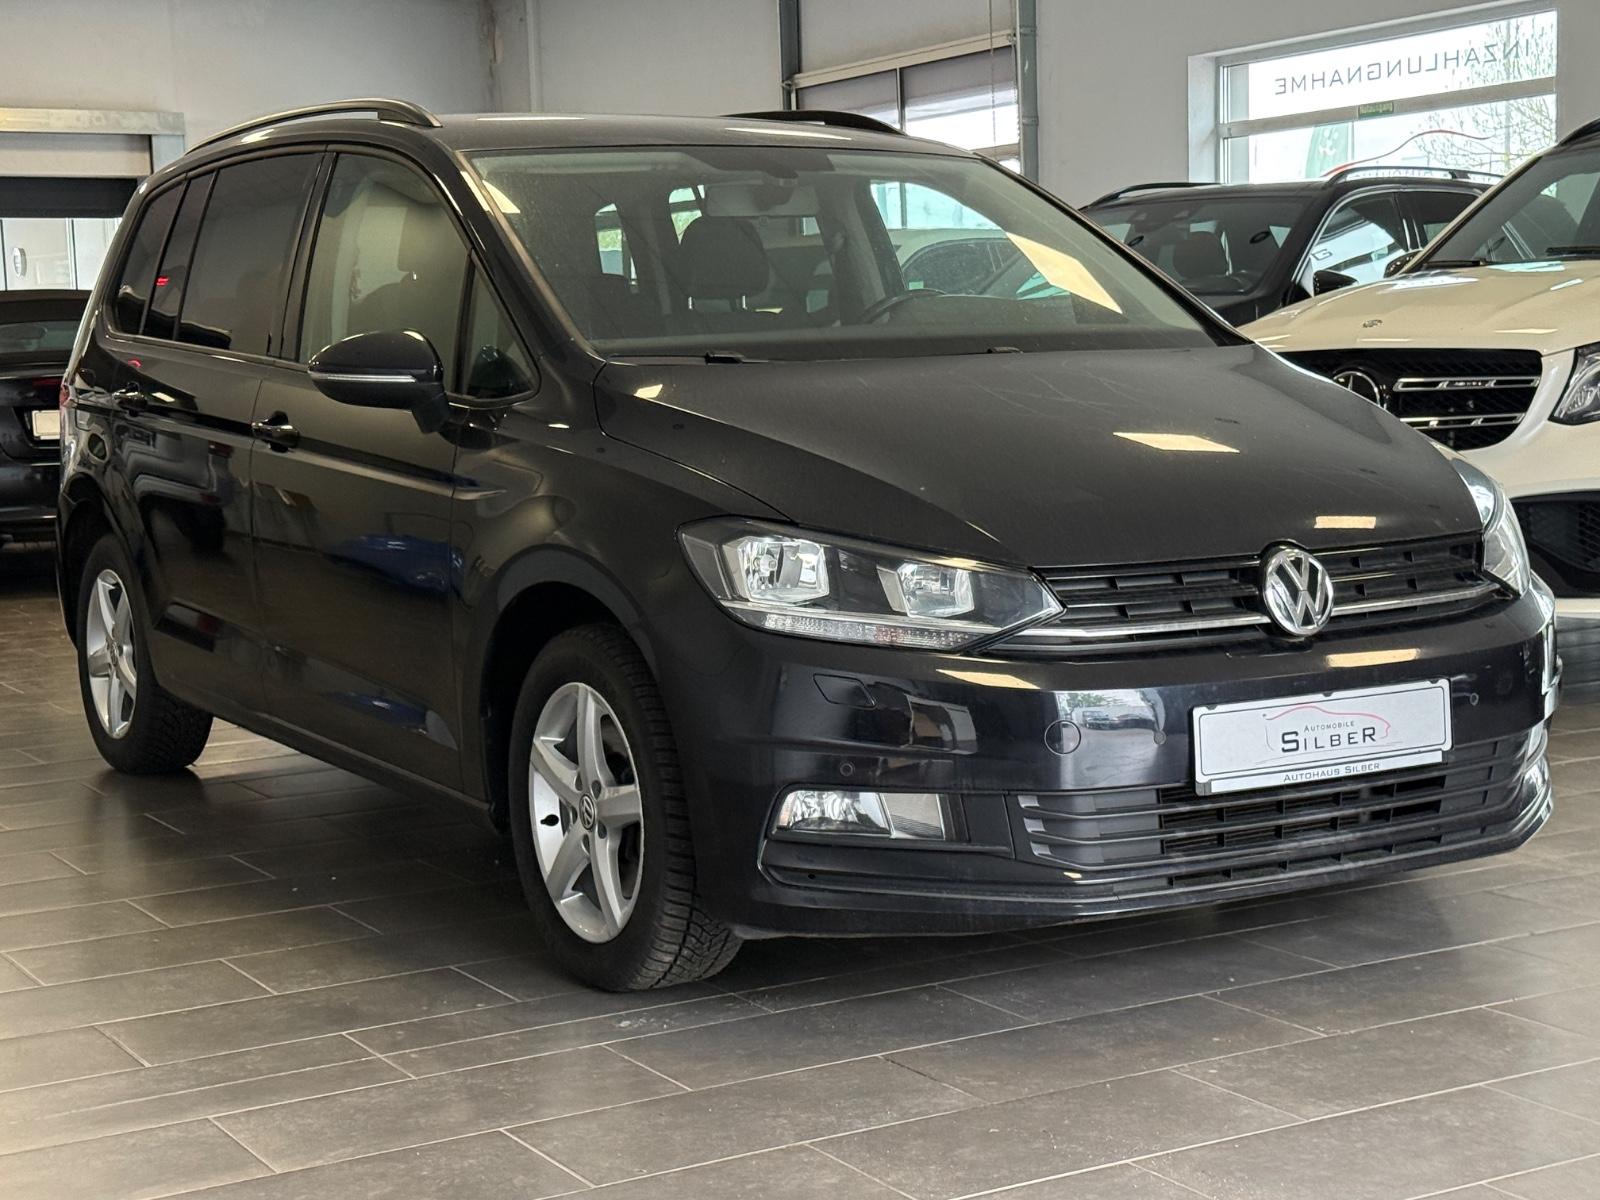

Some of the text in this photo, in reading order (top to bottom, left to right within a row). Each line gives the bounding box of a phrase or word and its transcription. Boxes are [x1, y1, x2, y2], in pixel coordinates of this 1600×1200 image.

[1303, 720, 1355, 733] AUTOMOBILE
[1281, 727, 1376, 753] SILBER
[1283, 763, 1380, 782] AUTOHAUS SILBER
